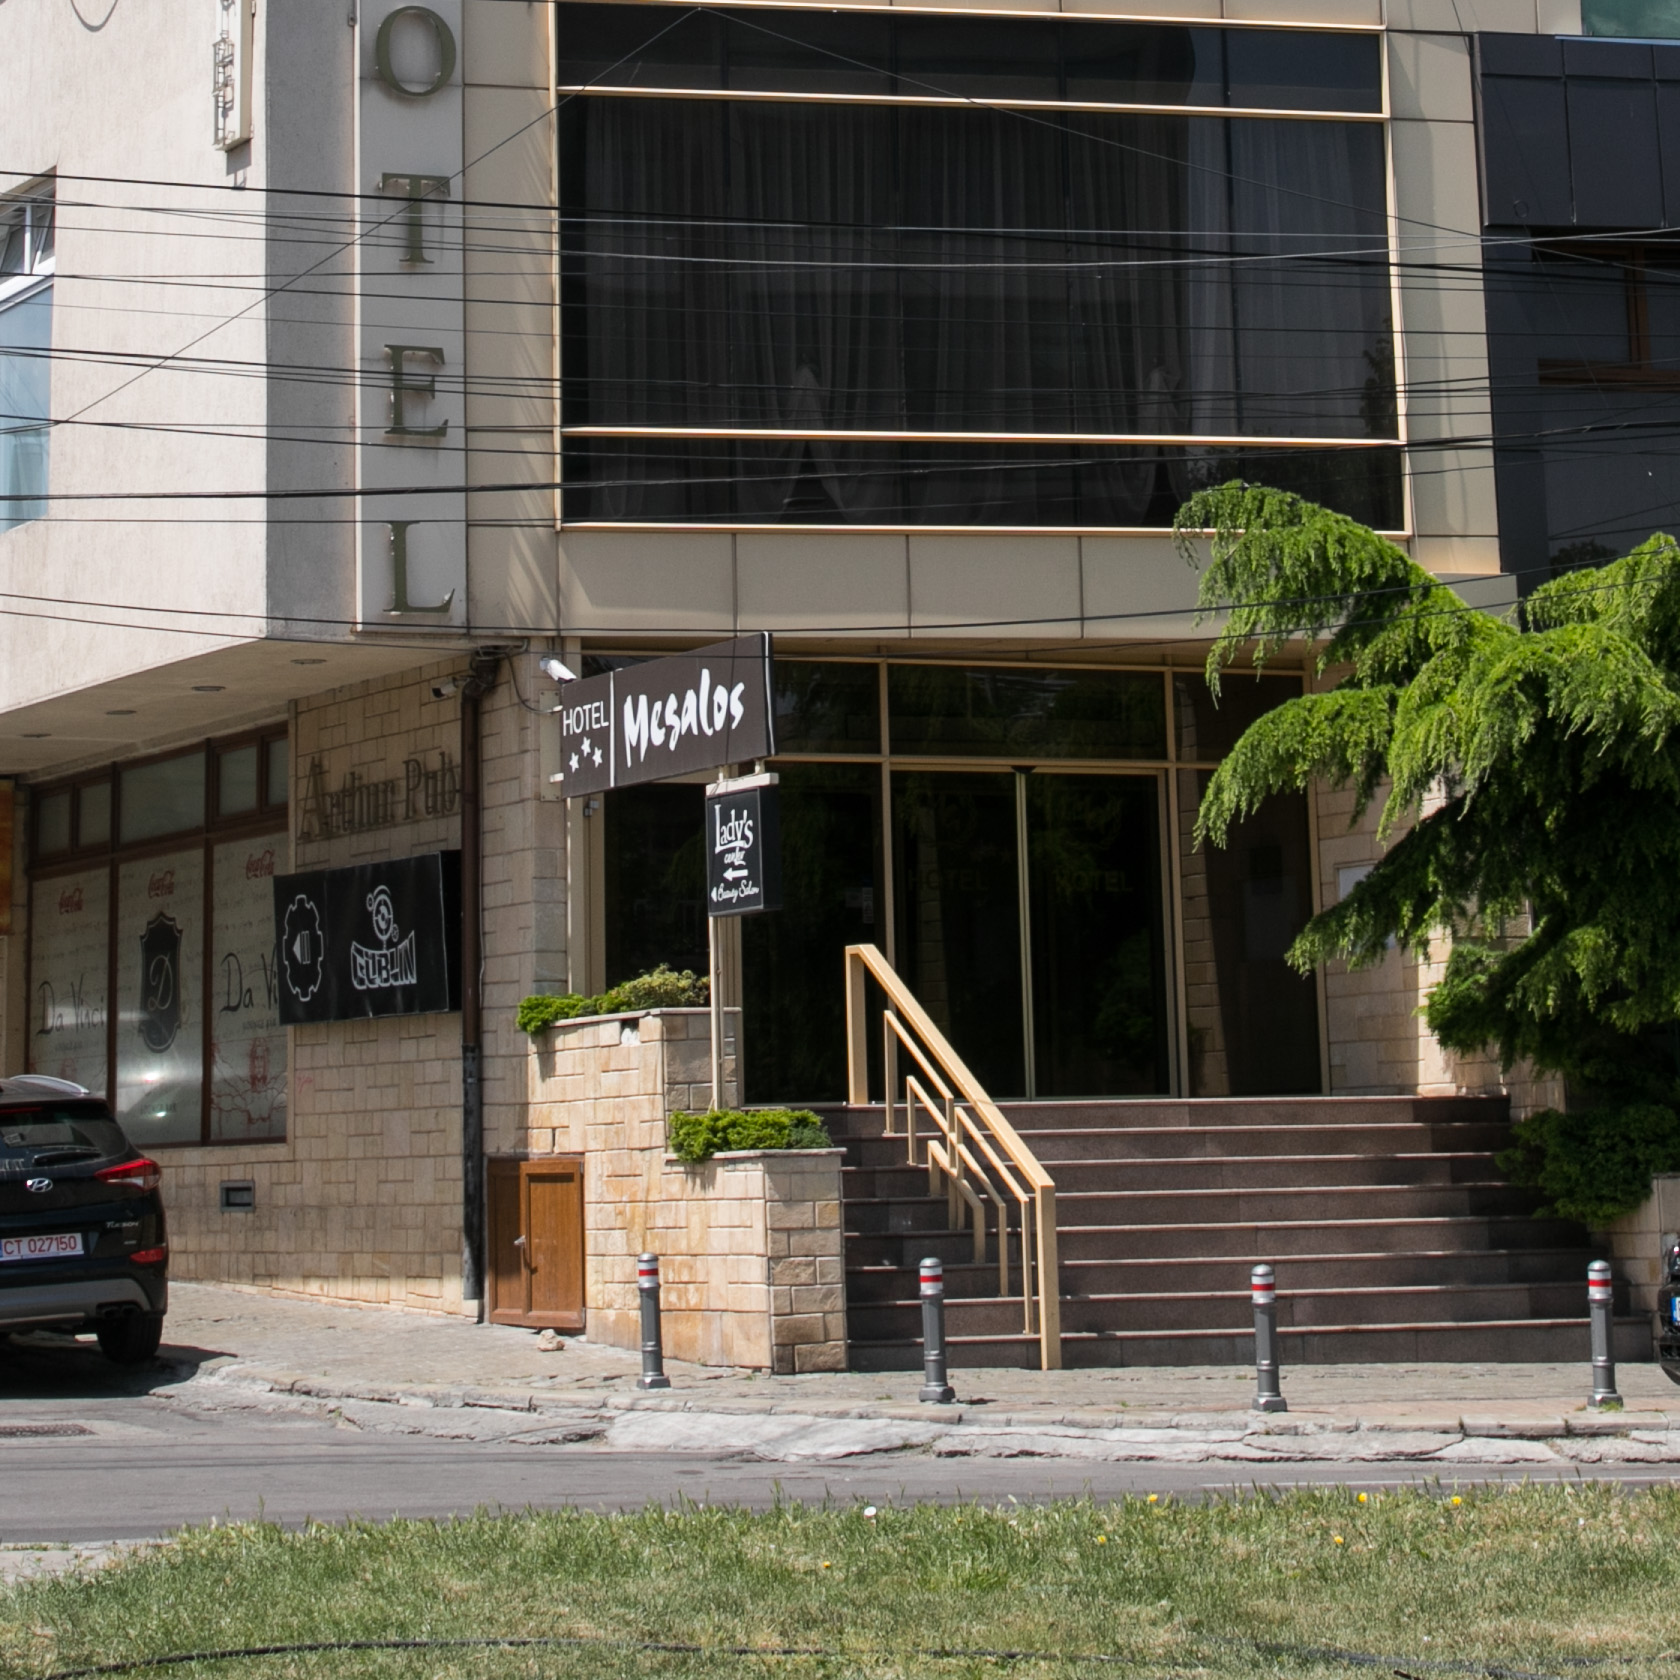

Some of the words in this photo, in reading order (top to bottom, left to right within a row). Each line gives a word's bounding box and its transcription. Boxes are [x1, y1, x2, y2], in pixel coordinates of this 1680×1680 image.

[563, 700, 609, 736] HOTEL
[624, 668, 745, 768] Mesalos
[403, 751, 458, 820] Pub
[714, 804, 754, 854] Lady's
[3, 1240, 23, 1256] CT
[28, 1235, 78, 1254] 027150
